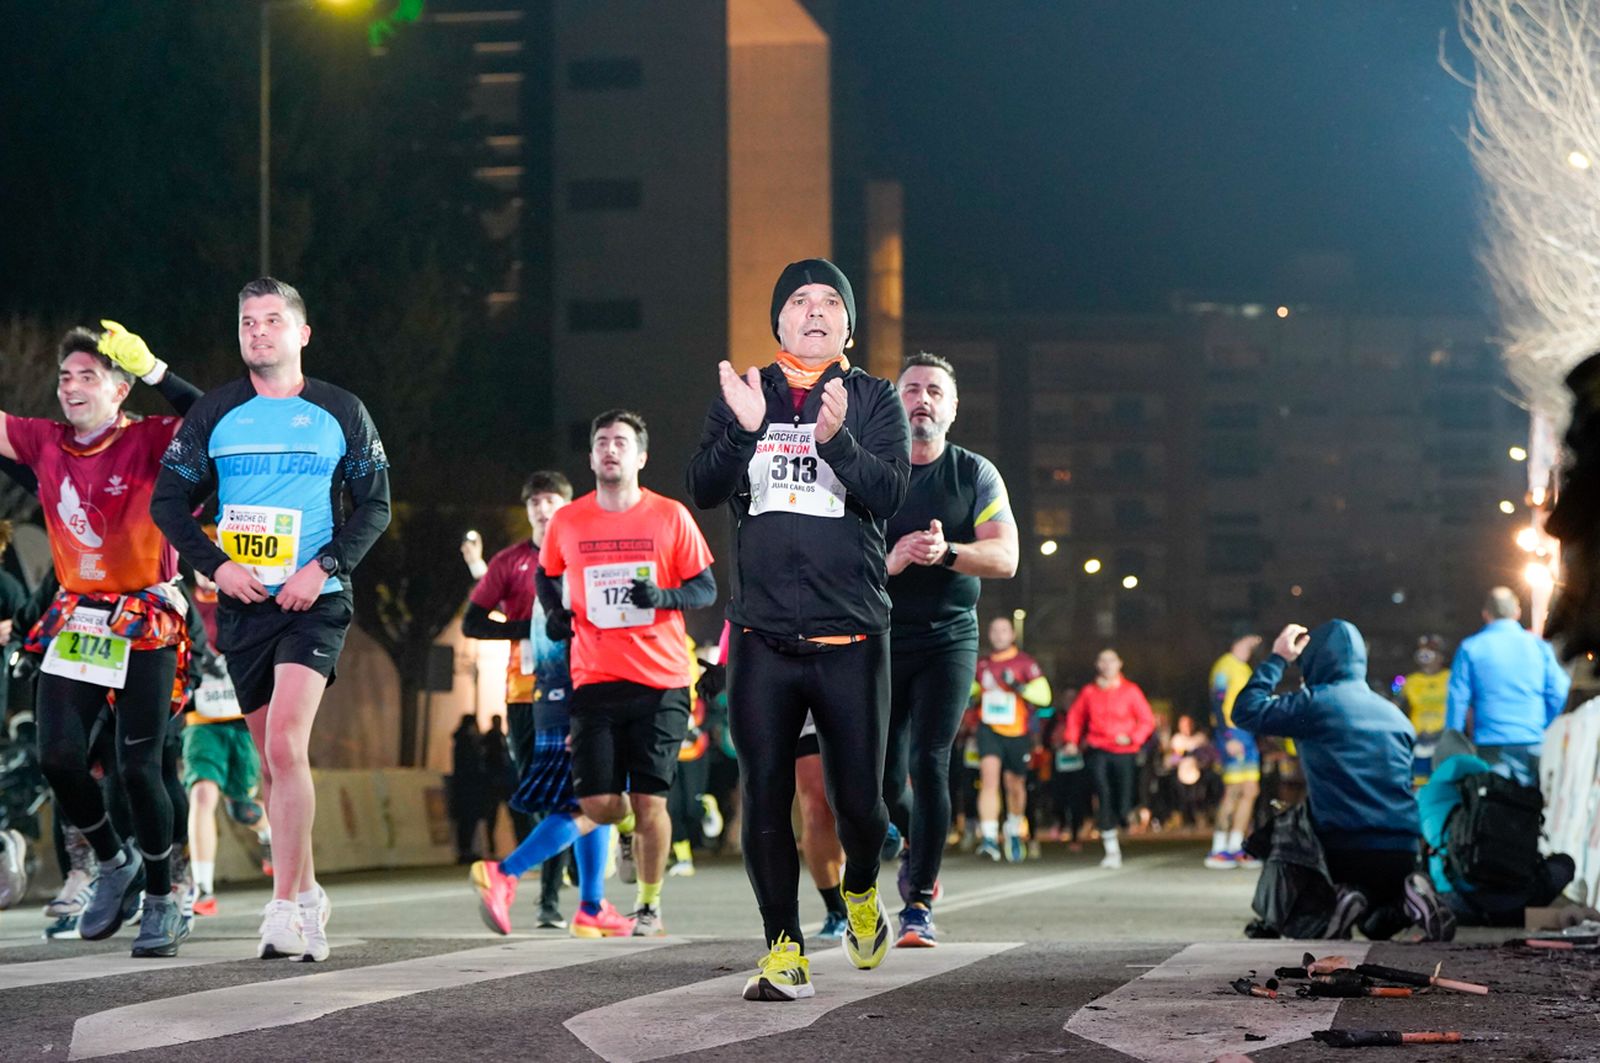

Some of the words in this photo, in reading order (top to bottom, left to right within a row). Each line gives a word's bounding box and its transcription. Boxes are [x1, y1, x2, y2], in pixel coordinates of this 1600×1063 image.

[767, 432, 798, 442] NOCHE
[800, 434, 811, 443] DE
[756, 444, 774, 454] SAN
[221, 456, 271, 477] MEDIA
[275, 455, 331, 477] LEGUA
[771, 454, 818, 484] 313
[771, 482, 789, 490] JUAN
[789, 483, 816, 493] CARLOS
[69, 514, 87, 535] 43
[235, 514, 256, 523] NOCHE
[257, 515, 267, 524] DE
[233, 533, 278, 558] 1750
[69, 632, 112, 660] 2174
